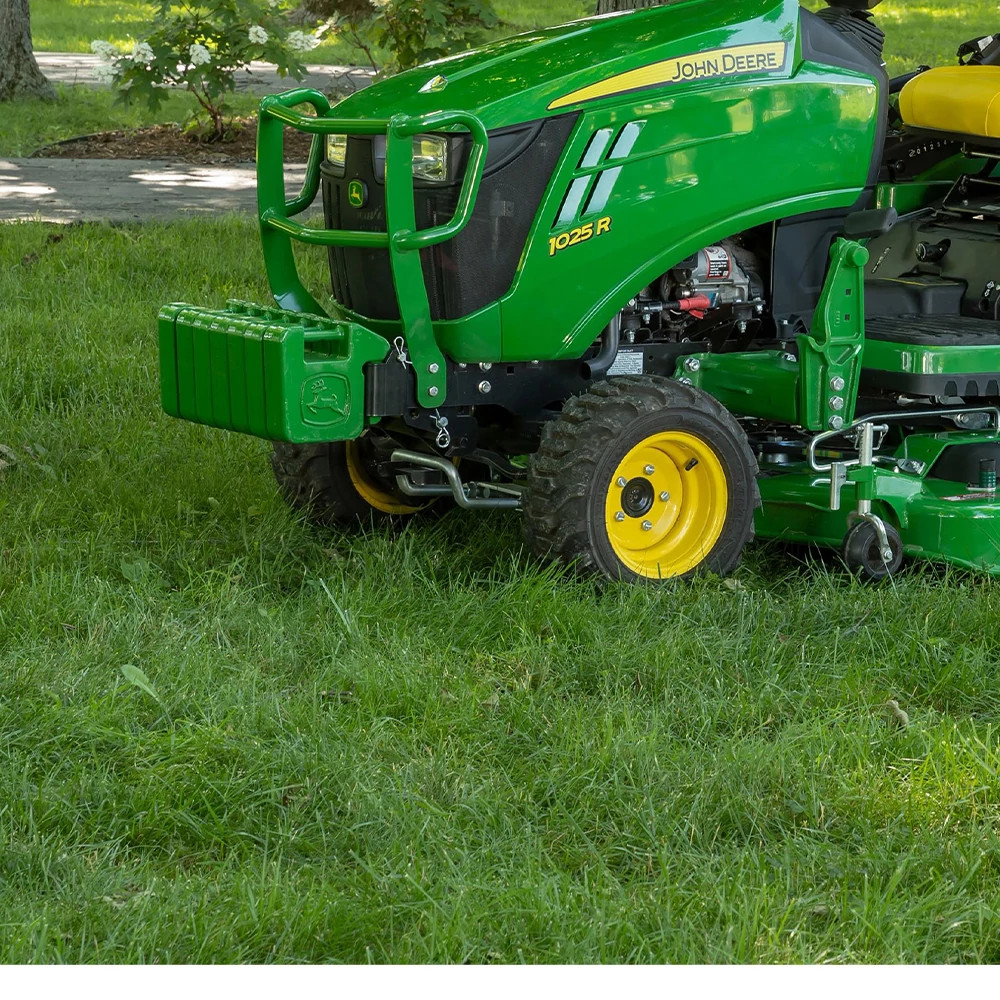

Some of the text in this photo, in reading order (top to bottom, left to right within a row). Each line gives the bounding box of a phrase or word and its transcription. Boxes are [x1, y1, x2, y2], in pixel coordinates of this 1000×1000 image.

[672, 52, 778, 81] JOHN DEERE
[548, 216, 612, 256] 1025 R
